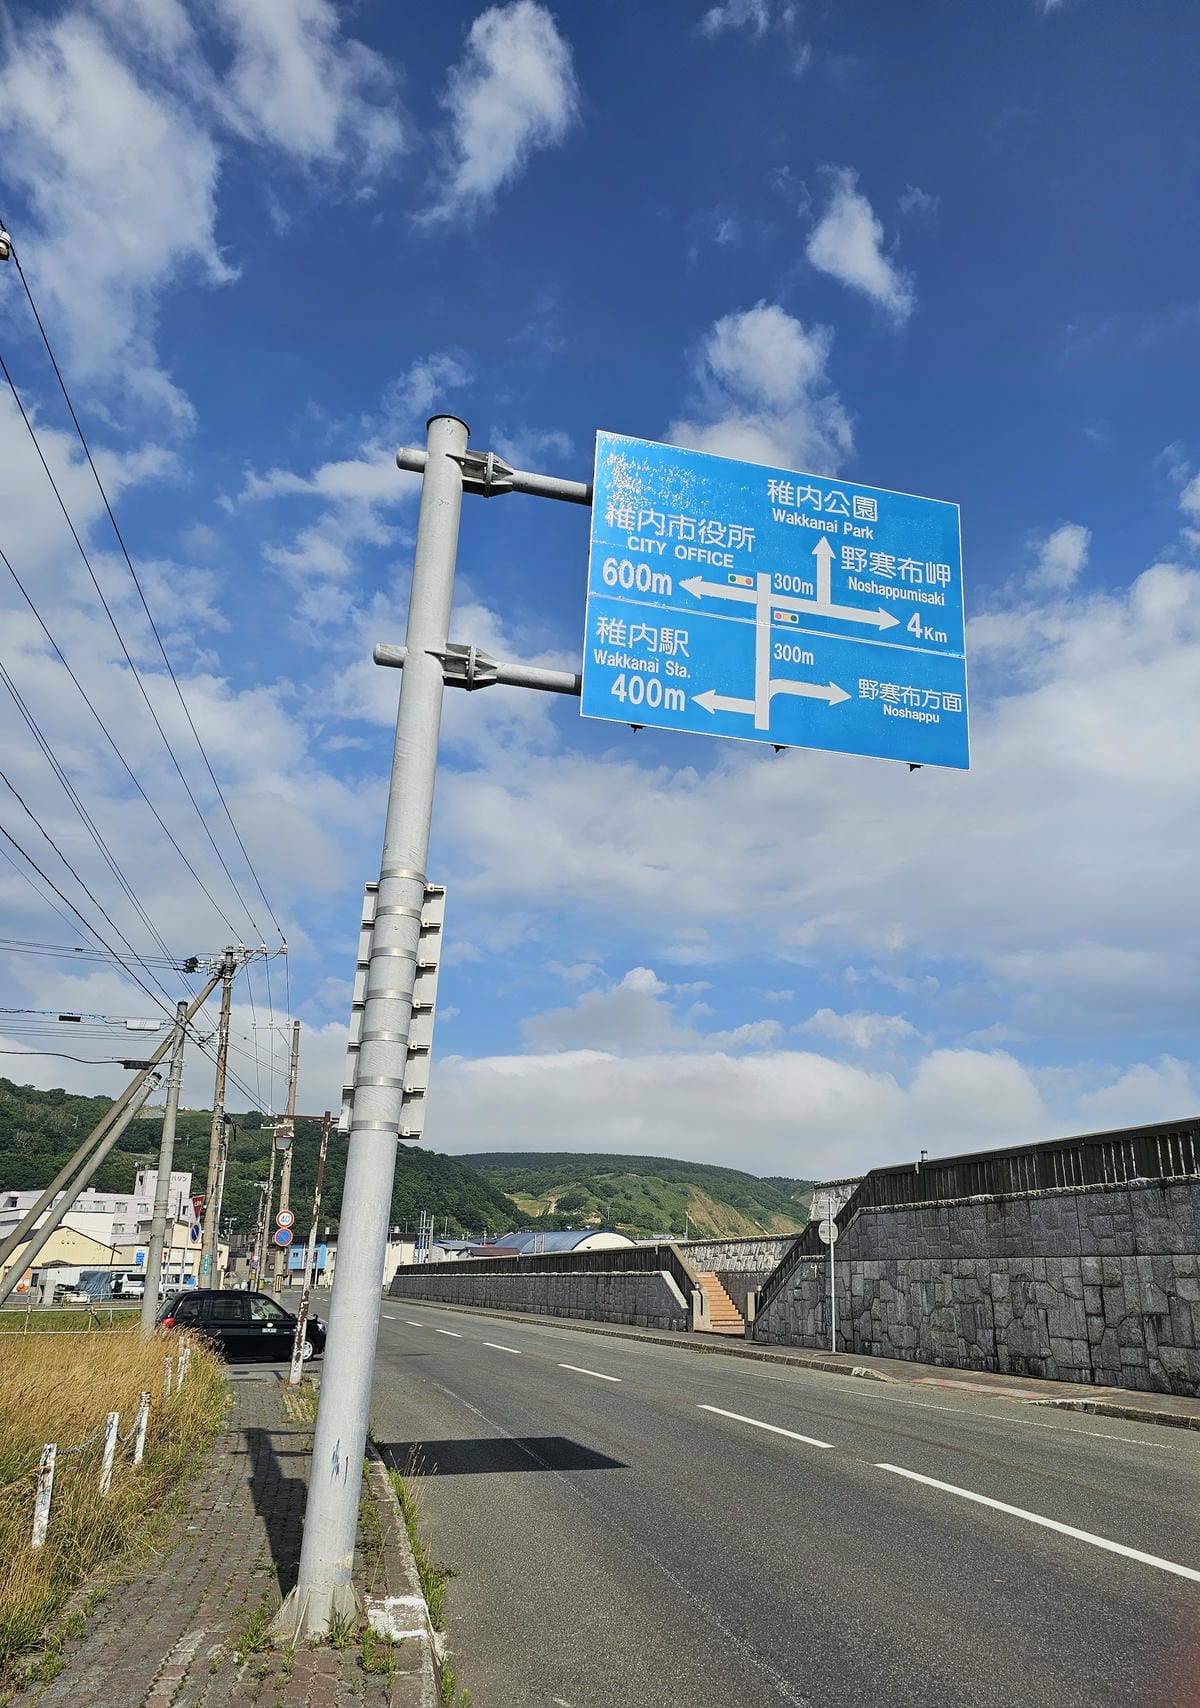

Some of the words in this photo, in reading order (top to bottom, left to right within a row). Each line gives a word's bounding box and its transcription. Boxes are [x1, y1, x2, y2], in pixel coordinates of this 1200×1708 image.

[767, 479, 878, 522] 稚内公園
[605, 503, 756, 552] 稚内市役所
[772, 508, 838, 533] Wakkanai
[843, 522, 874, 540] Park
[627, 535, 667, 555] CITY
[674, 545, 734, 568] OFFICE
[841, 545, 951, 588] 野寒布岬
[602, 557, 672, 596] 600m
[774, 573, 814, 595] 300m
[848, 576, 945, 606] Noshappumisaki
[595, 616, 690, 658] 稚内駅
[593, 649, 659, 673] Wakkanai
[665, 660, 691, 678] Sta.
[774, 643, 814, 665] 300m
[611, 673, 685, 712] 400m
[858, 678, 962, 713] 野寒布方面
[883, 704, 940, 723] Noshappu
[281, 1215, 290, 1223] 40
